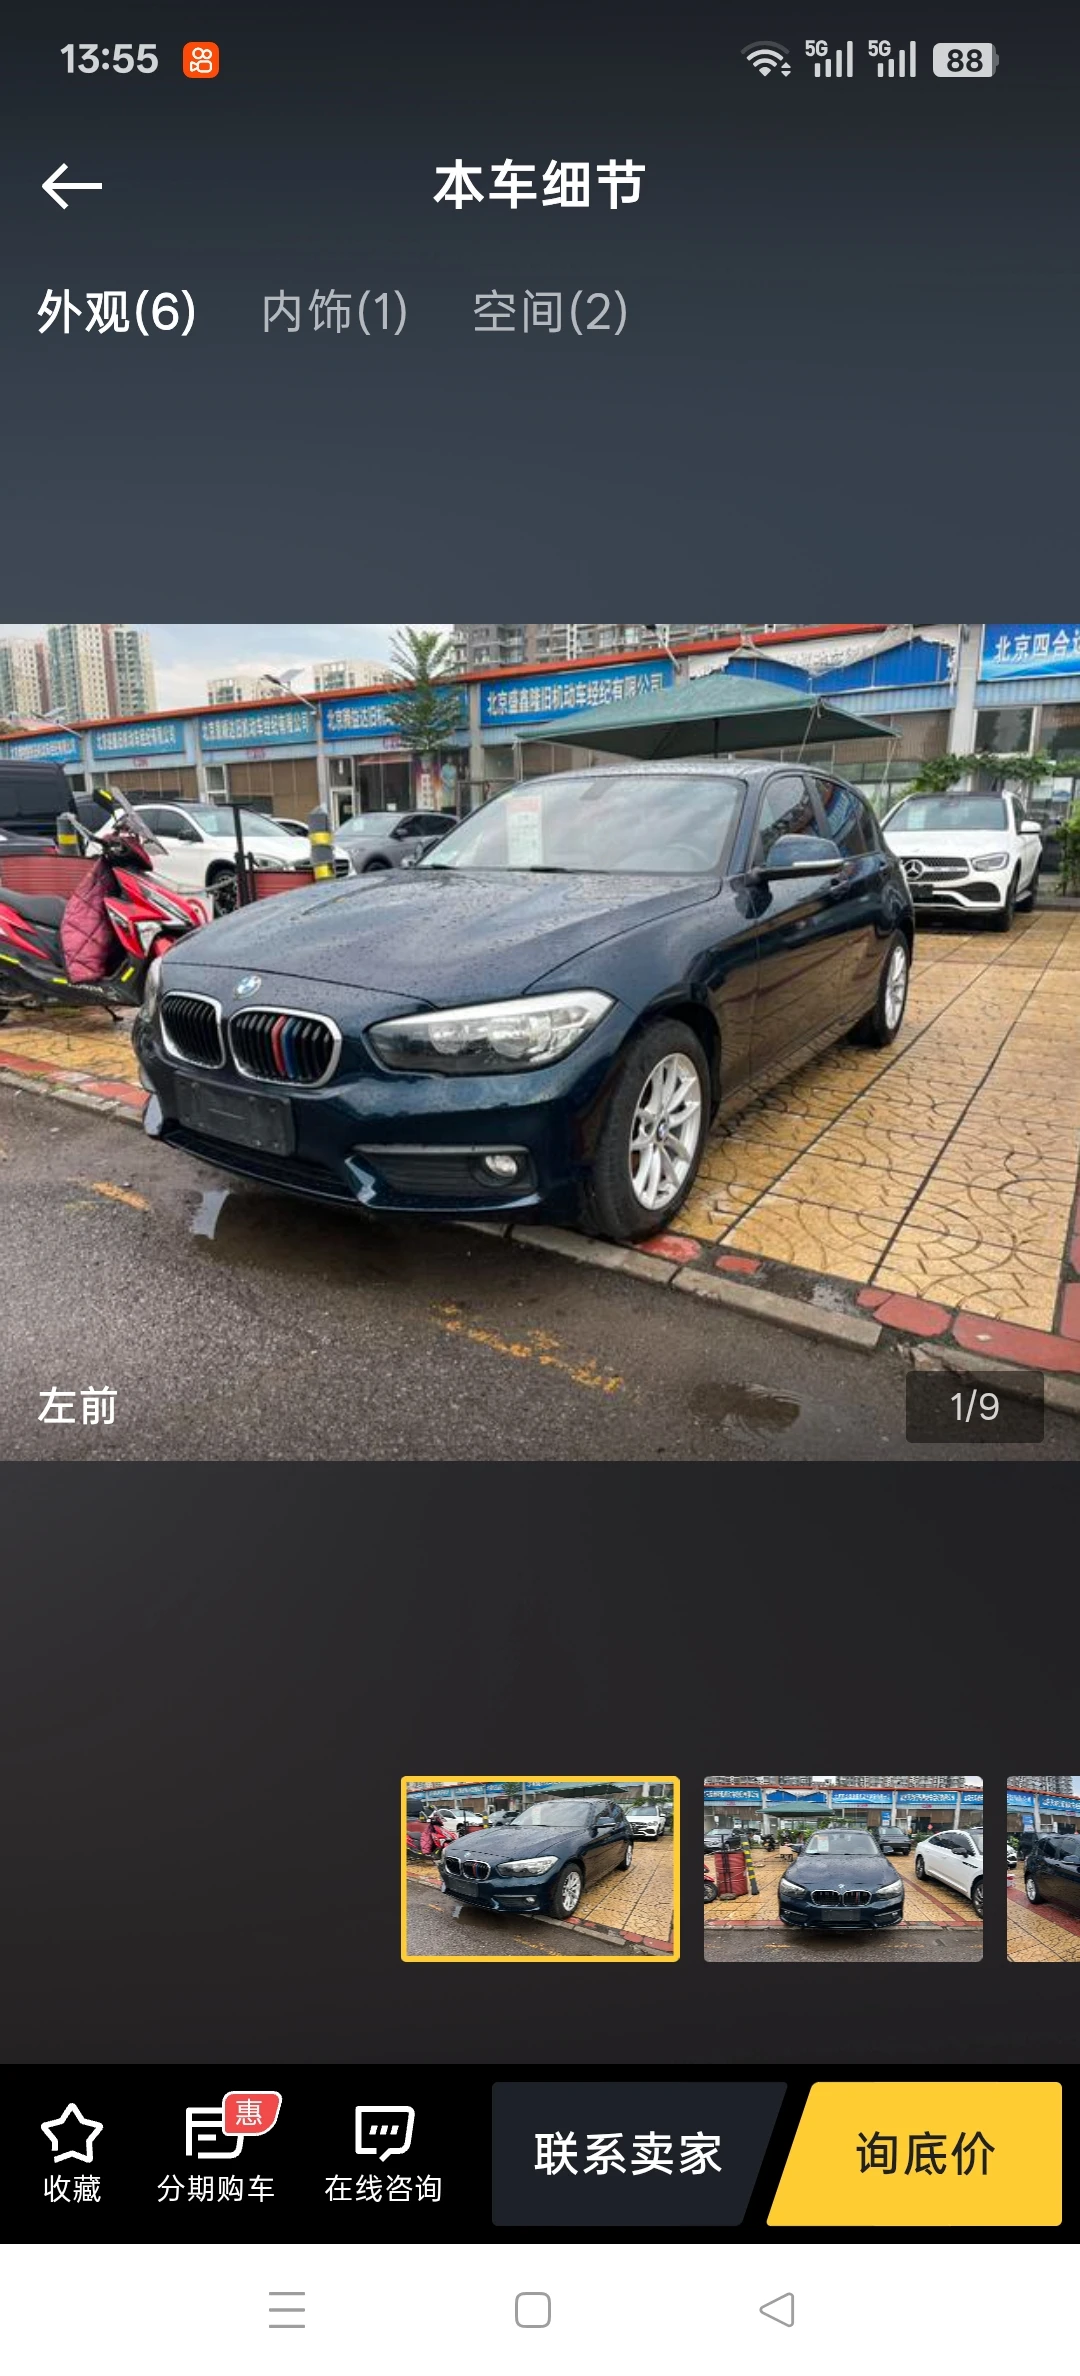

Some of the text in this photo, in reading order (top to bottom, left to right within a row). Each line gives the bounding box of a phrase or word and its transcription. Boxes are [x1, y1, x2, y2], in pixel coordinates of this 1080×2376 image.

[61, 44, 158, 73] 13:55
[805, 40, 828, 57] 5G
[868, 40, 891, 57] 5G
[947, 49, 983, 72] 88
[433, 158, 645, 209] 本车细节
[37, 289, 194, 336] 外观(6)
[264, 289, 406, 335] 内饰(1)
[474, 289, 626, 335] 空间(2)
[236, 2098, 262, 2126] 惠
[534, 2131, 722, 2175] 联系卖家
[856, 2131, 995, 2175] 询底价
[43, 2174, 101, 2203] 收藏
[157, 2174, 274, 2203] 分期购车
[325, 2174, 441, 2203] 在线咨询
